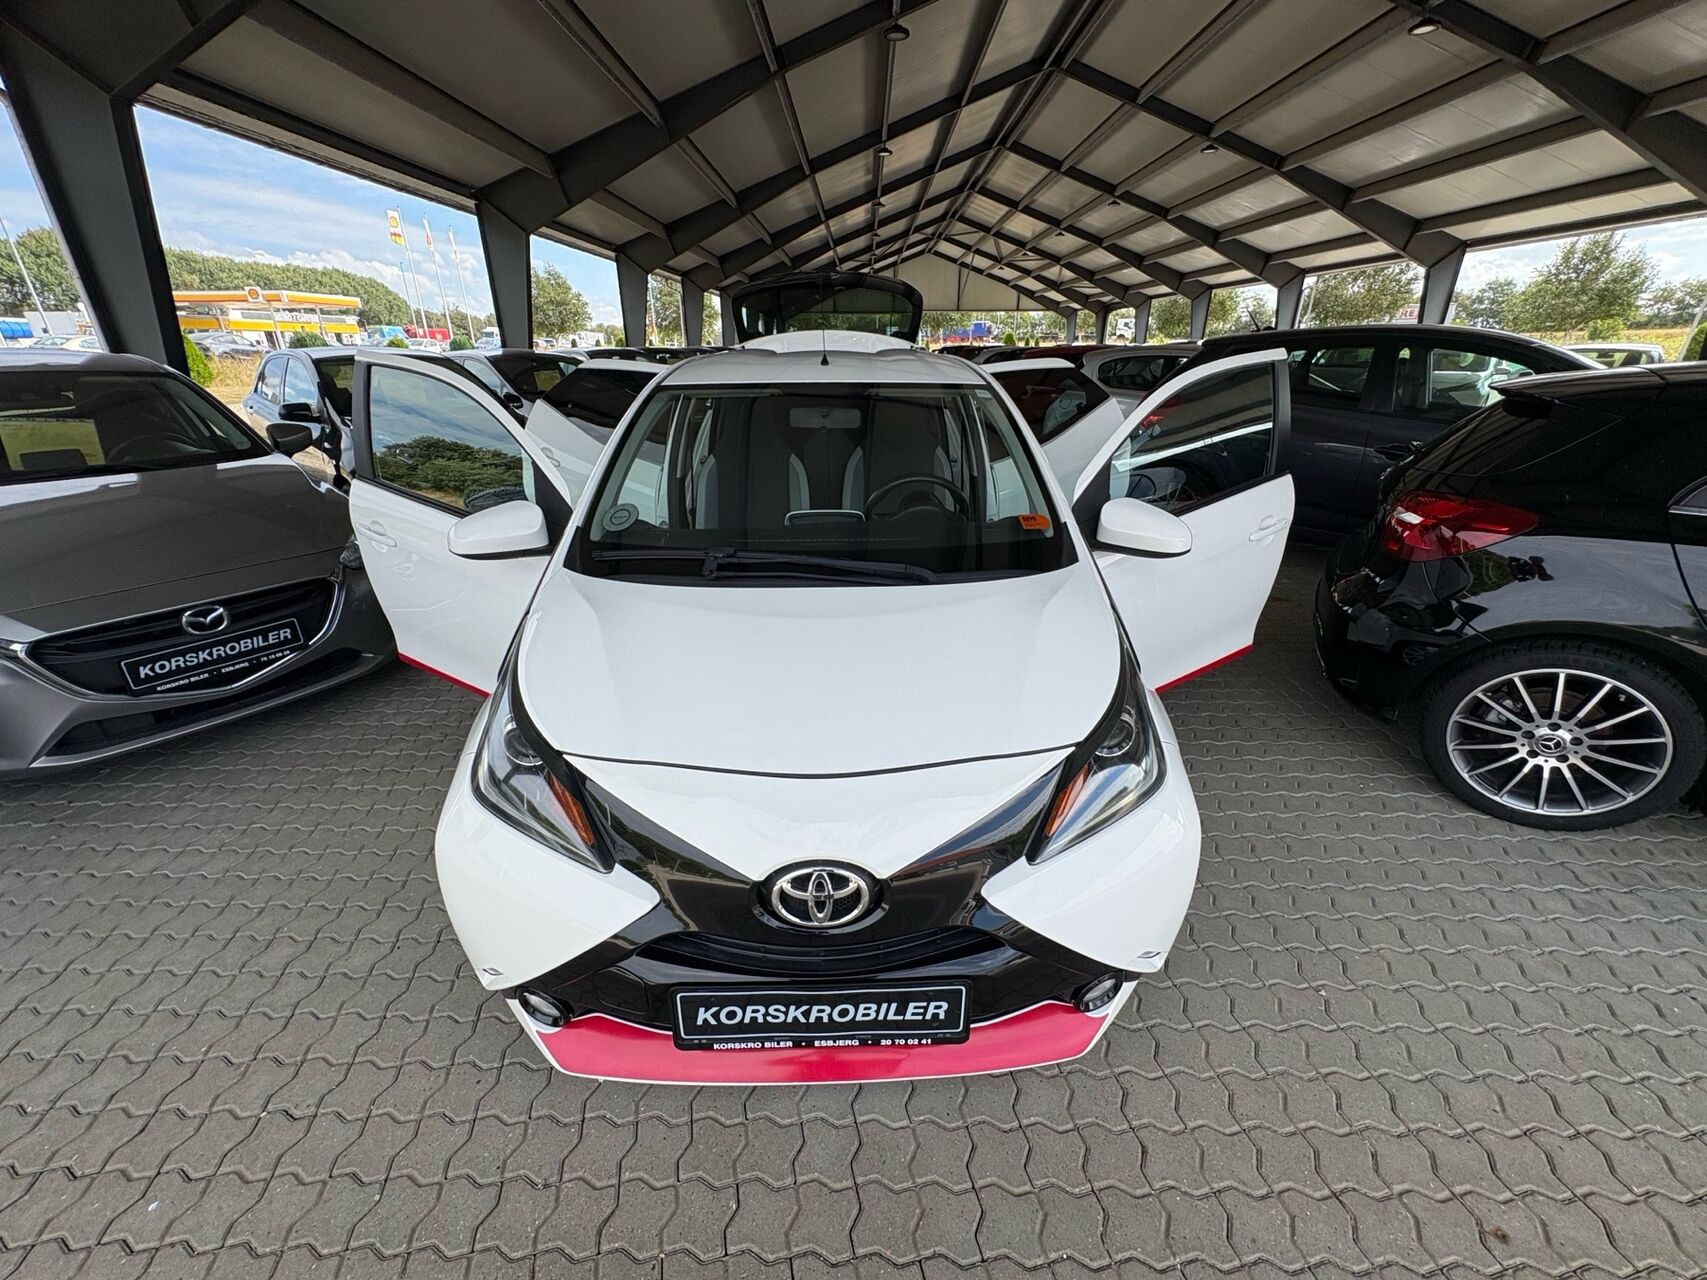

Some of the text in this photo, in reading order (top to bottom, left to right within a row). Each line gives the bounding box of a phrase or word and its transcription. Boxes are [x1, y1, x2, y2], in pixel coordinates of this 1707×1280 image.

[139, 628, 292, 679] KORSKROBILER
[156, 679, 189, 691] KORSKRO
[189, 673, 210, 683] BILER
[696, 1001, 949, 1026] KORSKROBILER
[713, 1041, 762, 1050] KORSKRO
[764, 1040, 793, 1048] BILER
[814, 1039, 859, 1047] ESBJERG
